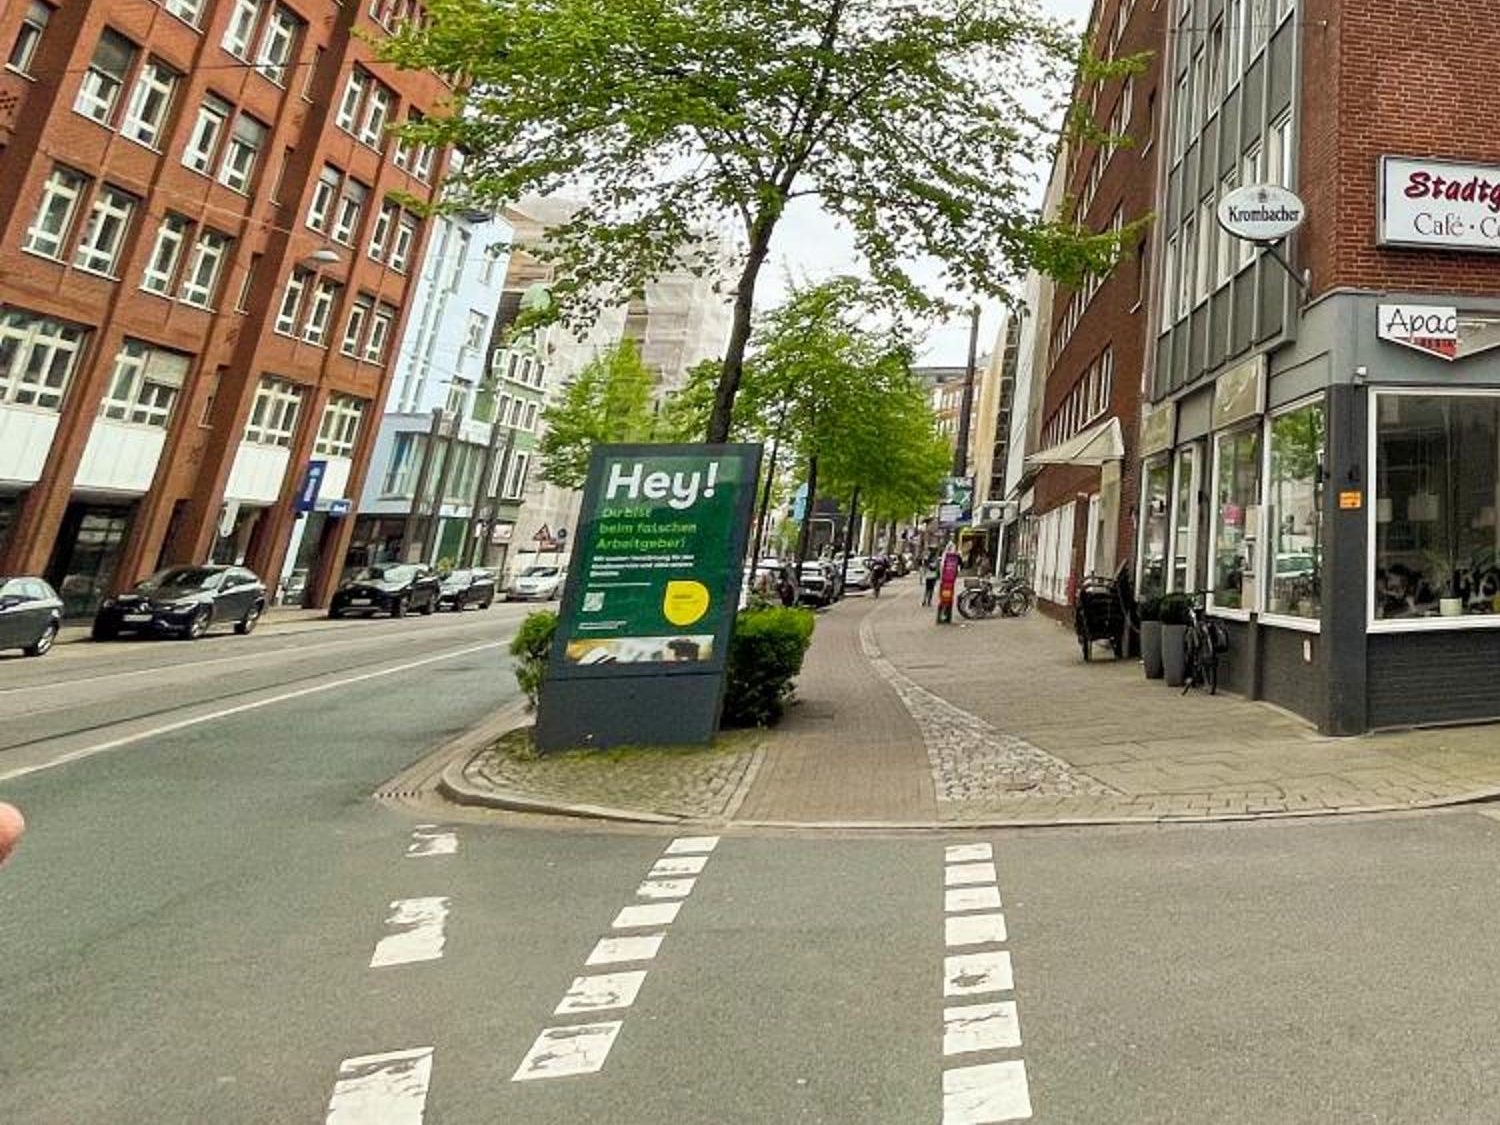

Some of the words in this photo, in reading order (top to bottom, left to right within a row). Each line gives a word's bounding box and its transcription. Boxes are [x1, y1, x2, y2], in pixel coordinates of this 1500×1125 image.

[1228, 204, 1300, 223] Krombacher
[1413, 212, 1463, 236] Café
[605, 462, 719, 509] Hey!
